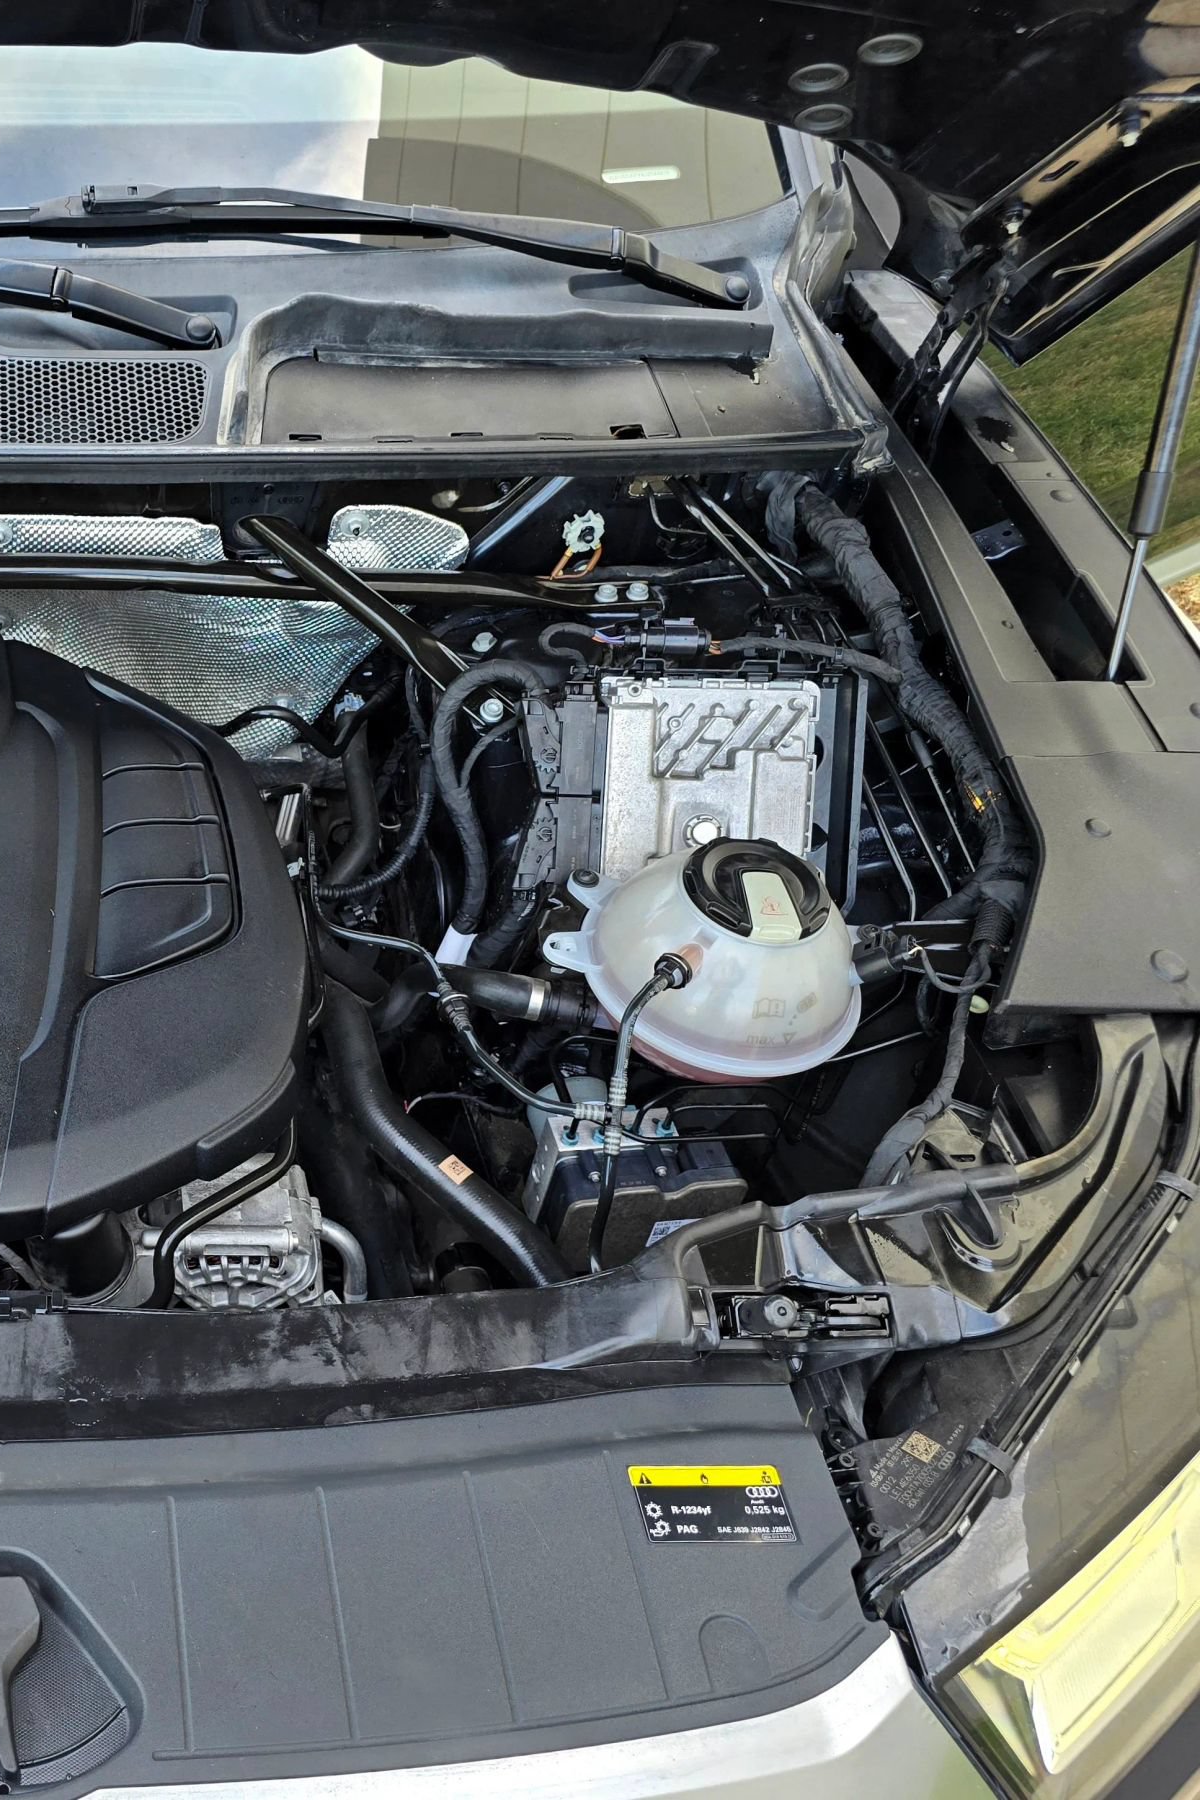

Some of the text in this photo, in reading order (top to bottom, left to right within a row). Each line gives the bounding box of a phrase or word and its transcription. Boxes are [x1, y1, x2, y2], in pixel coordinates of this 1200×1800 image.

[746, 1032, 776, 1046] max
[874, 1459, 888, 1470] Made
[888, 1437, 904, 1452] Mexico
[880, 1476, 896, 1493] 0012
[670, 1505, 785, 1516] R-1234yf 0,525 kg
[676, 1524, 699, 1534] PAG
